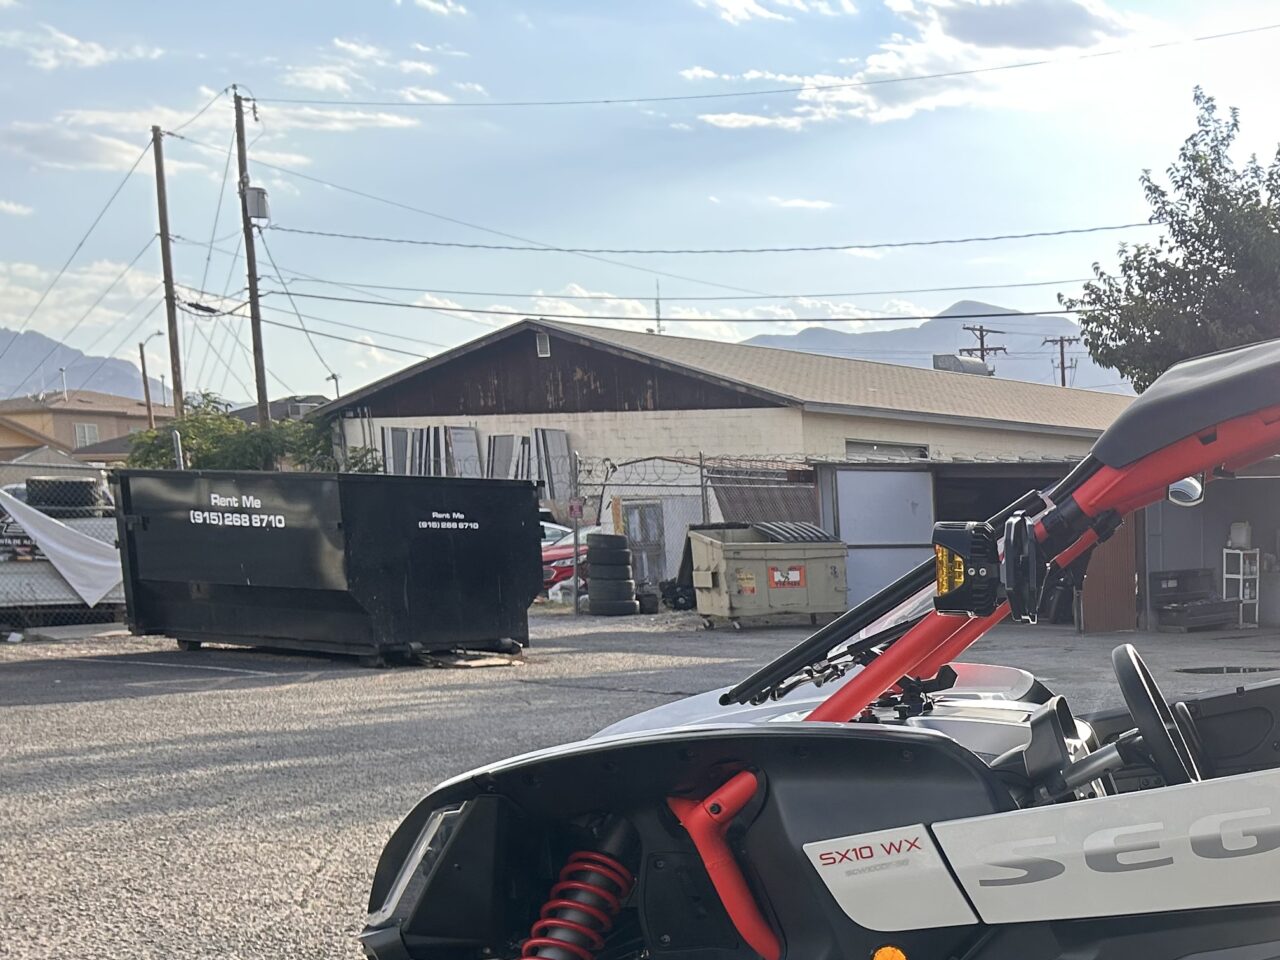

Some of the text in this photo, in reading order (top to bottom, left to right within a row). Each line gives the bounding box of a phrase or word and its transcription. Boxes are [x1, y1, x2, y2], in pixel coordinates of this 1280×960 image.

[210, 493, 261, 509] Rent Me
[190, 510, 285, 528] (915) 268 8710
[431, 511, 465, 519] Rent Me
[418, 521, 440, 529] (915)
[458, 522, 479, 530] 8710
[819, 837, 922, 866] SX10 WX
